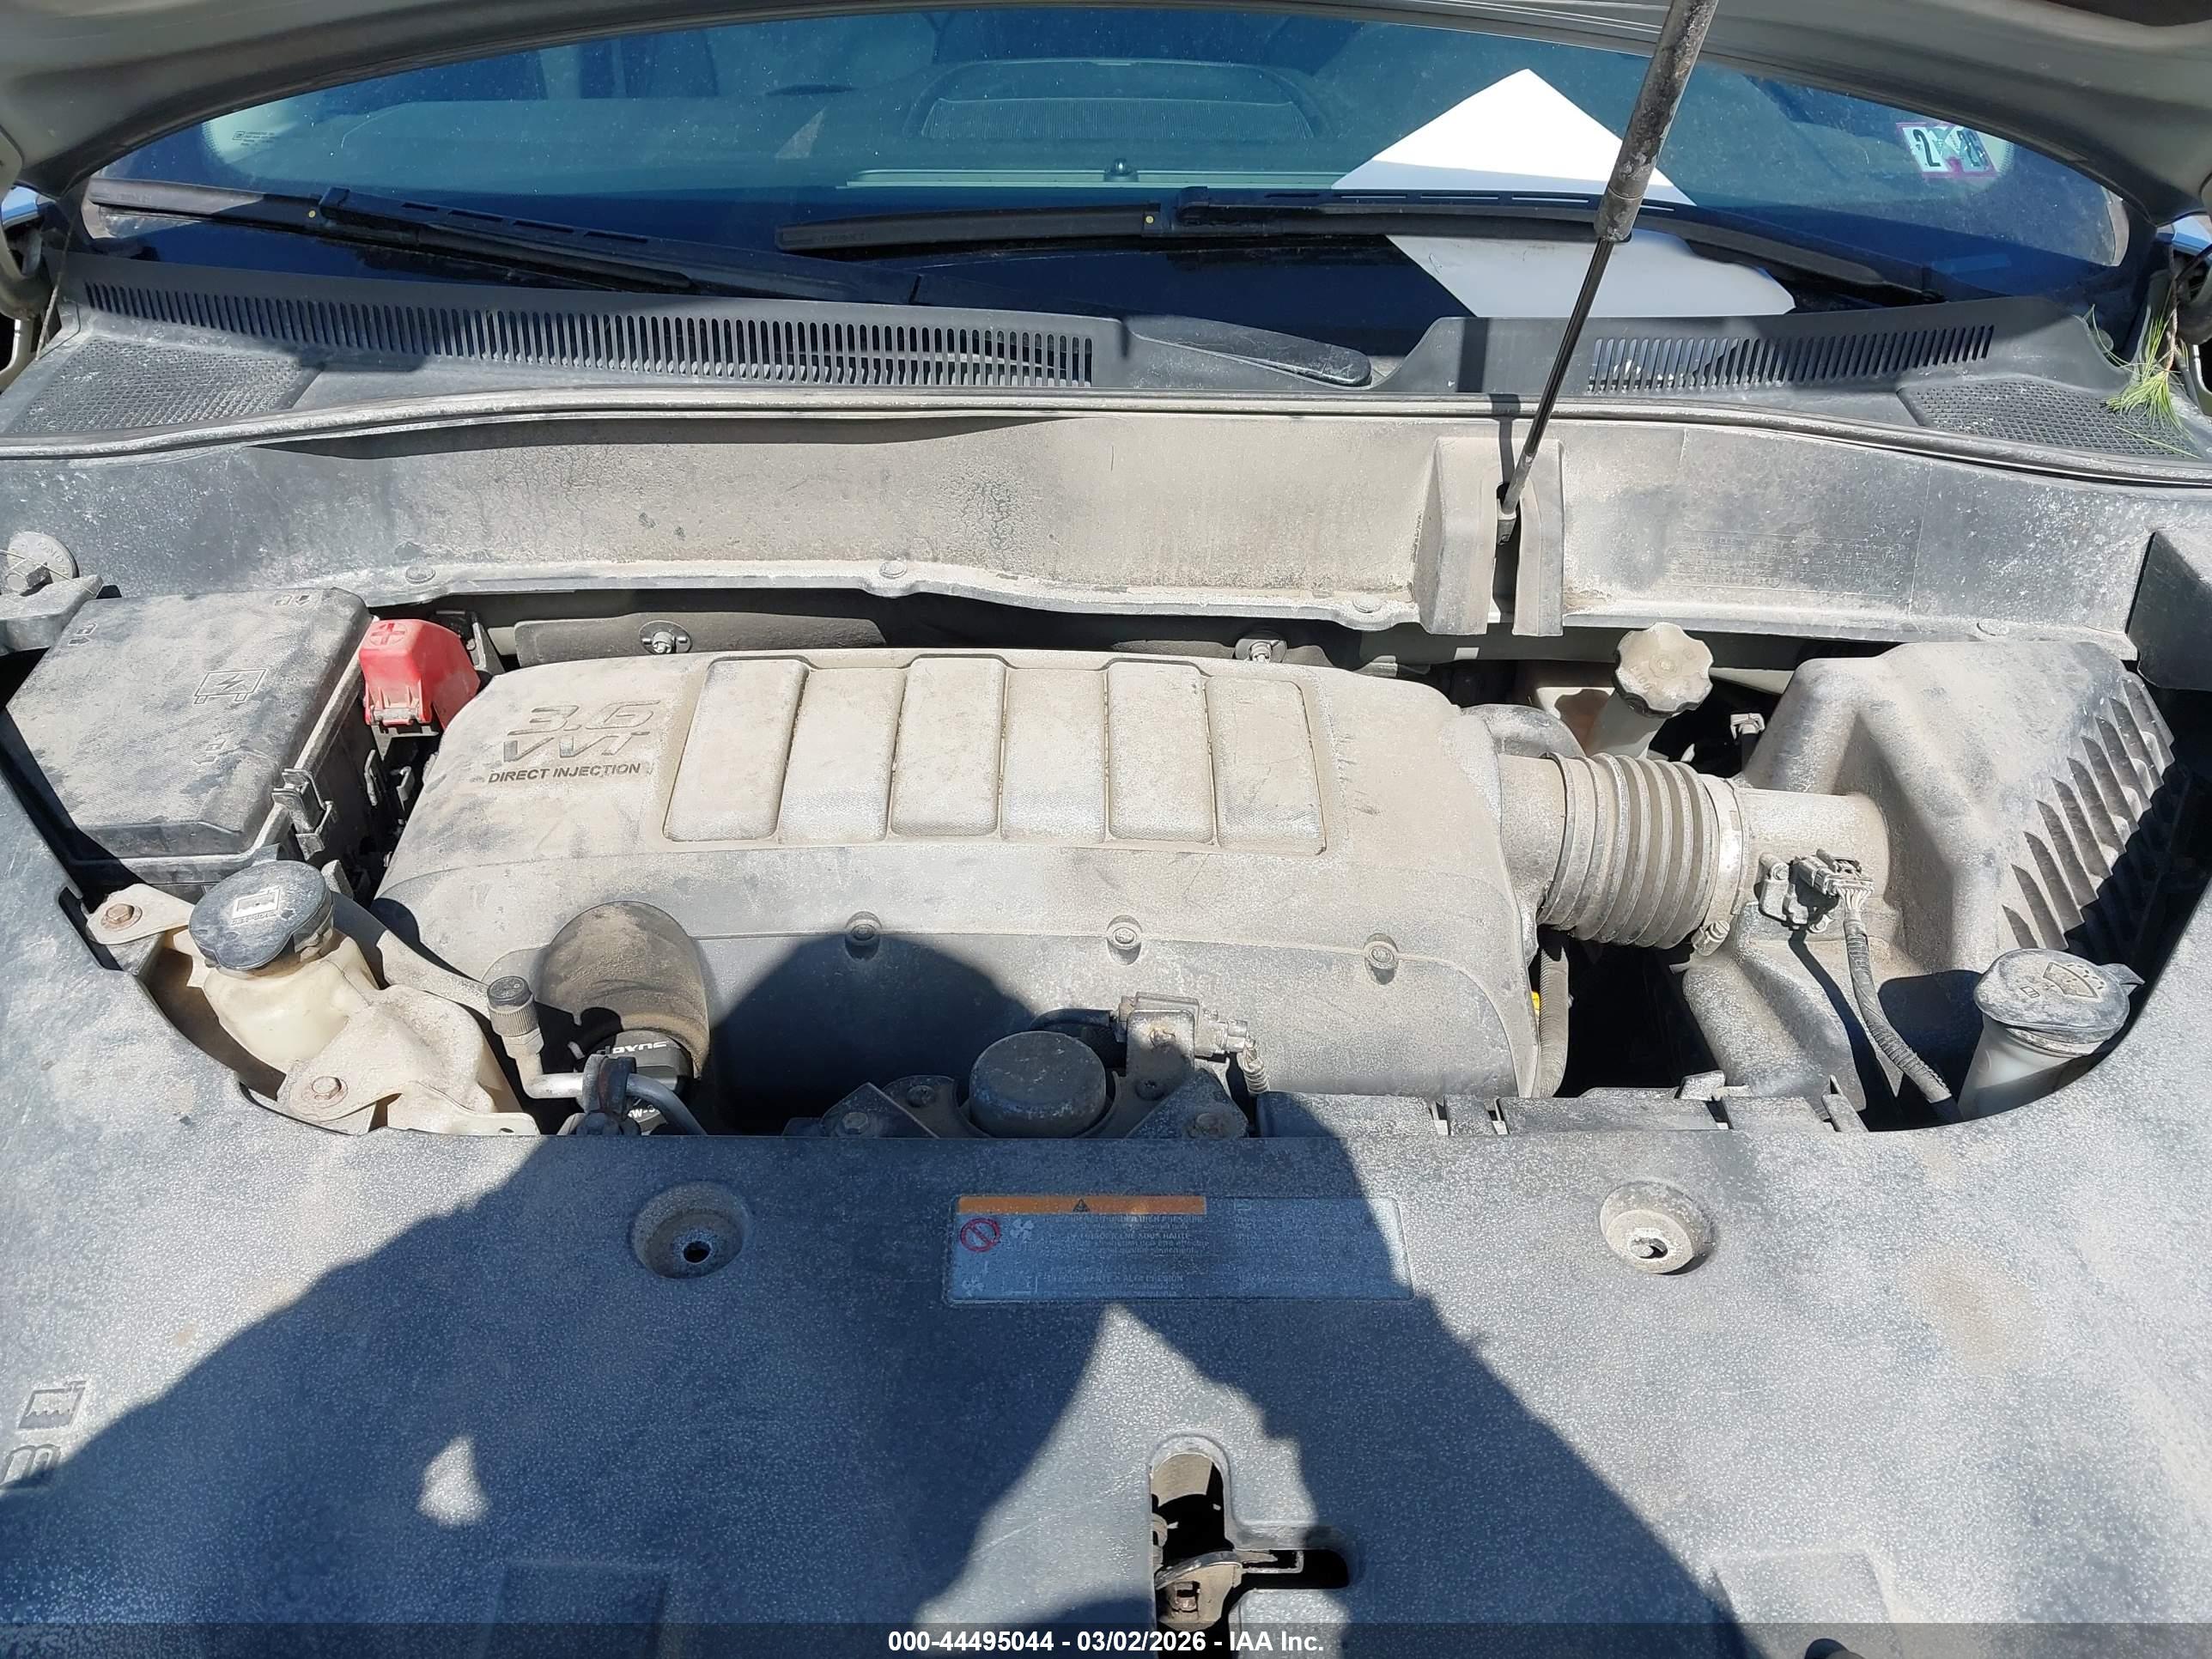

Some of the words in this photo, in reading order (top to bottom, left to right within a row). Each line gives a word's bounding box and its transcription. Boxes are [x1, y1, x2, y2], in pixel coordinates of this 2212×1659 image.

[507, 700, 660, 736] 3.6
[502, 731, 651, 763] VVT
[488, 768, 550, 783] DIRECT
[553, 763, 641, 778] INJECTION
